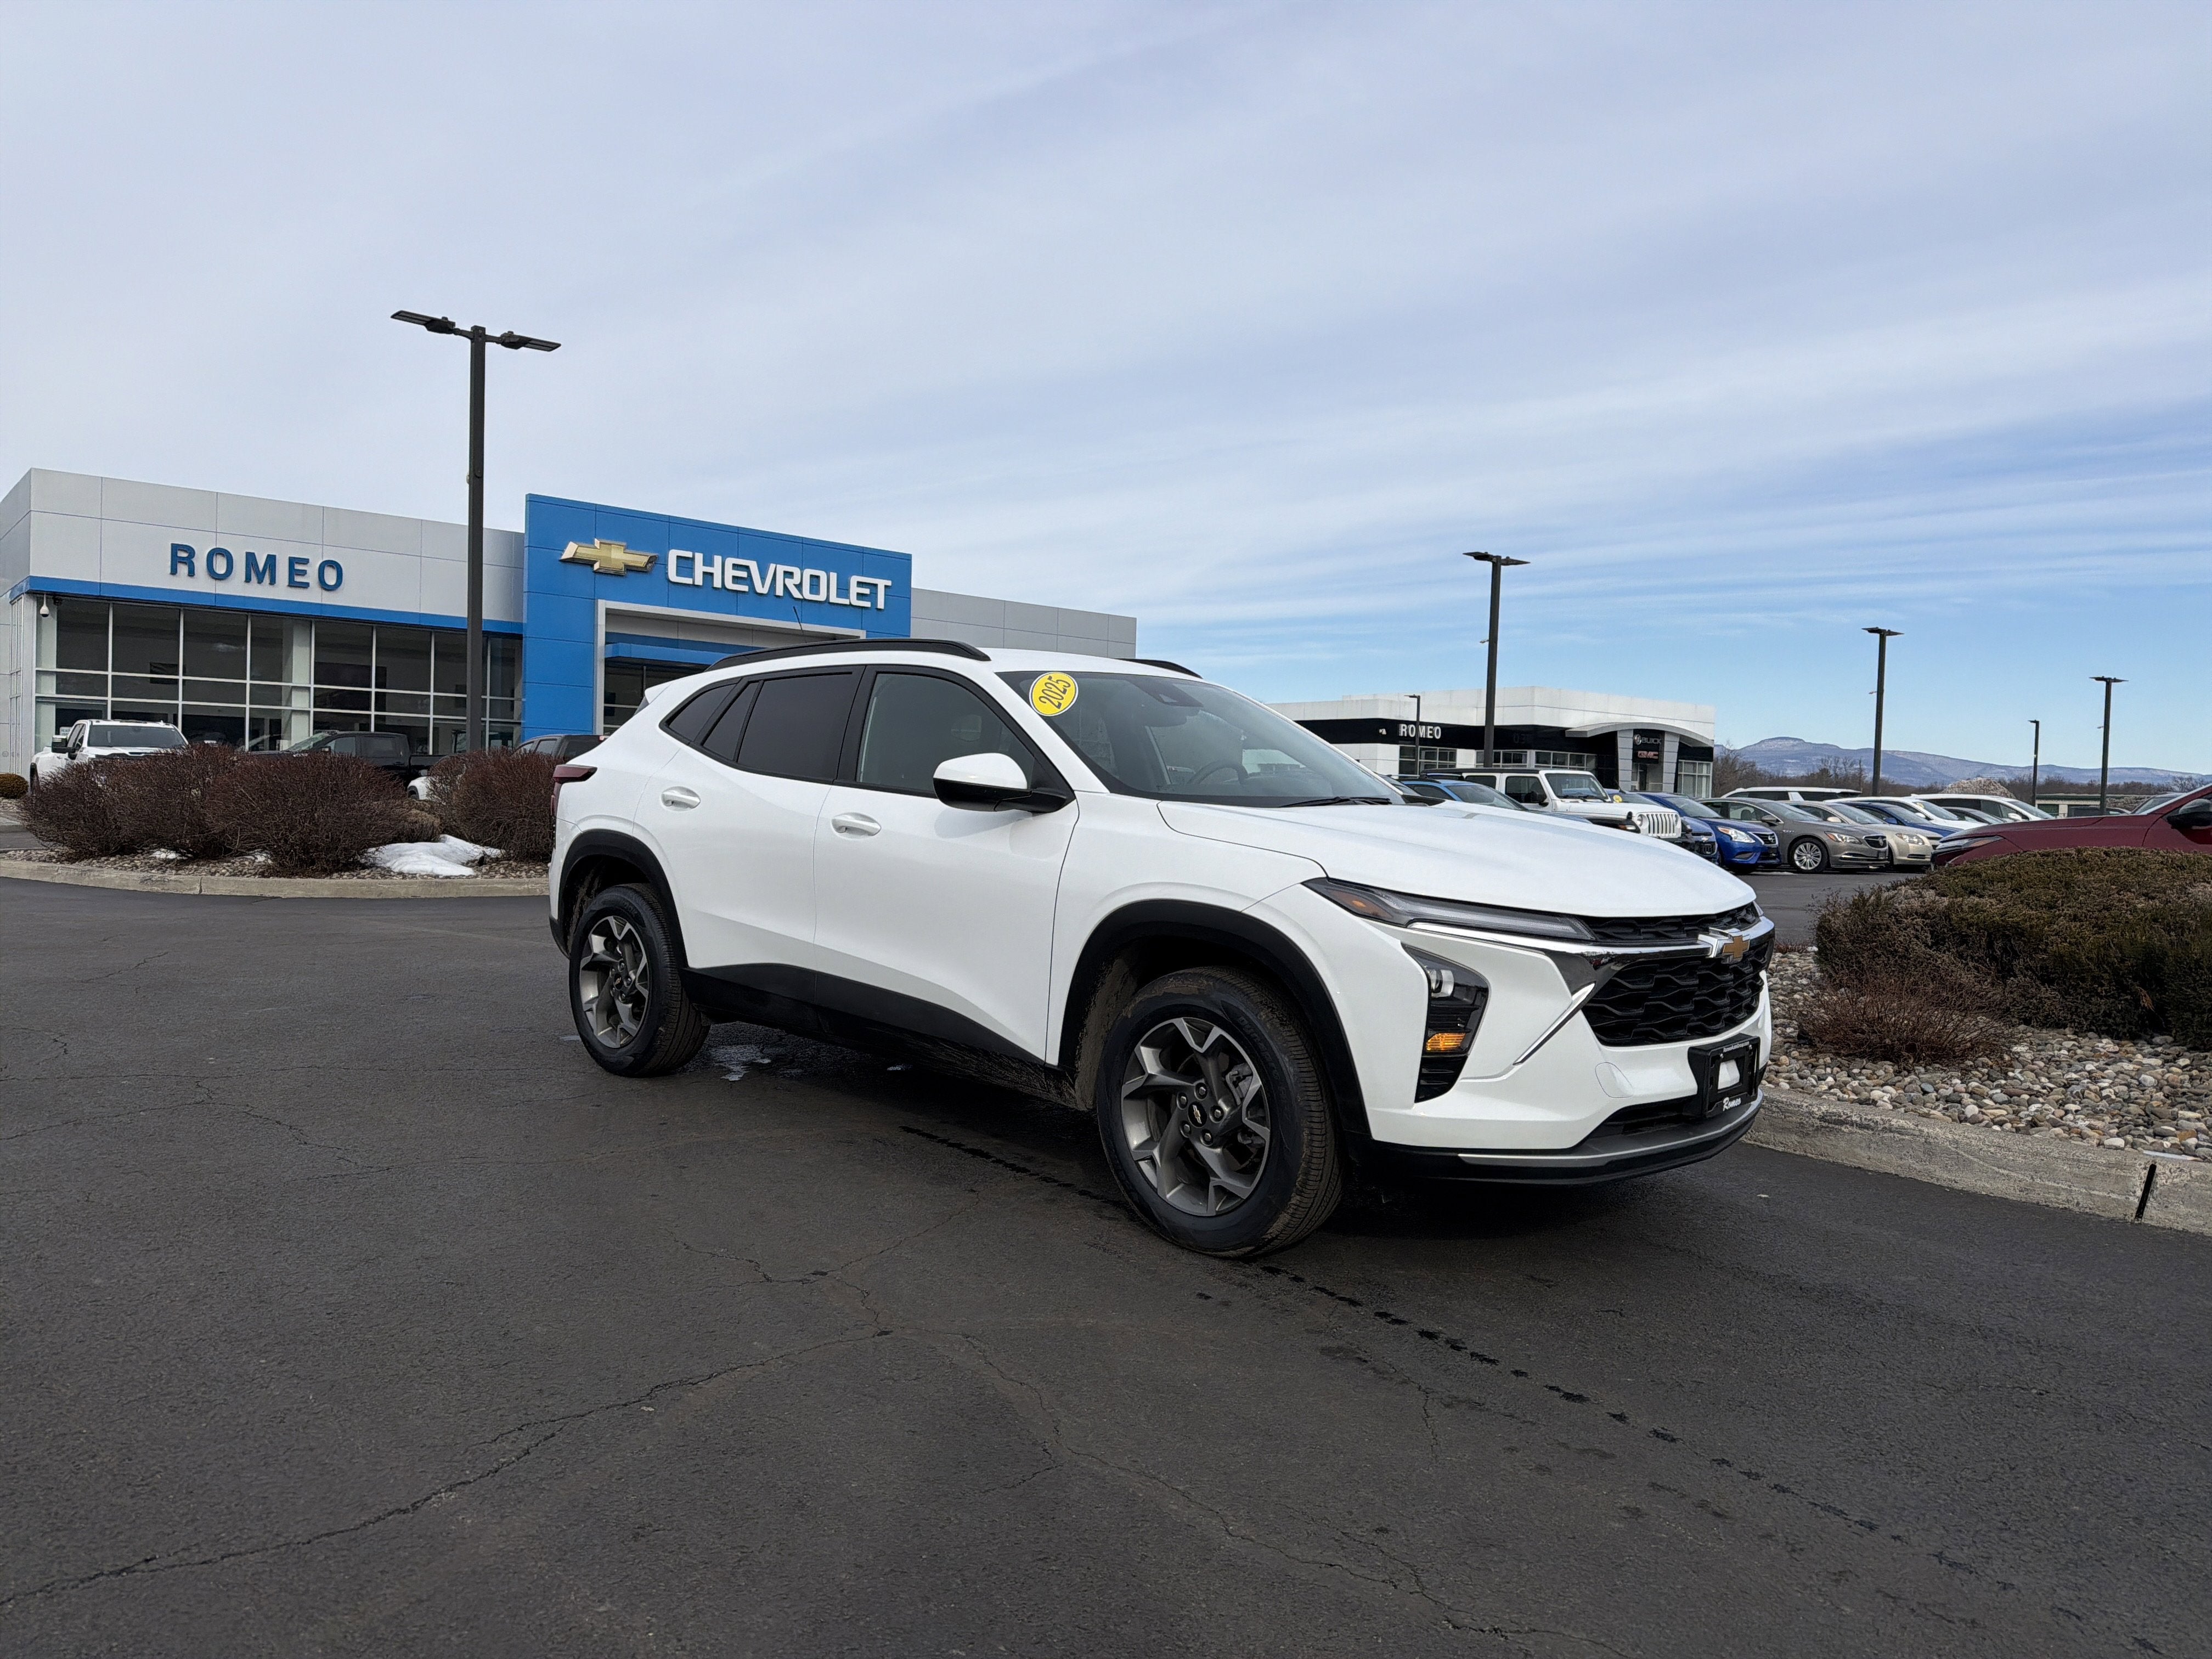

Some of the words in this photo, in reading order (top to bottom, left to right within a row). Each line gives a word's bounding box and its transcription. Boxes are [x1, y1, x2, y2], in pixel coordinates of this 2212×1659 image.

[170, 543, 343, 591] ROMEO
[668, 549, 892, 610] CHEVROLET
[1039, 675, 1071, 709] 2025
[1399, 724, 1441, 740] ROMEO
[1638, 751, 1658, 759] GMC
